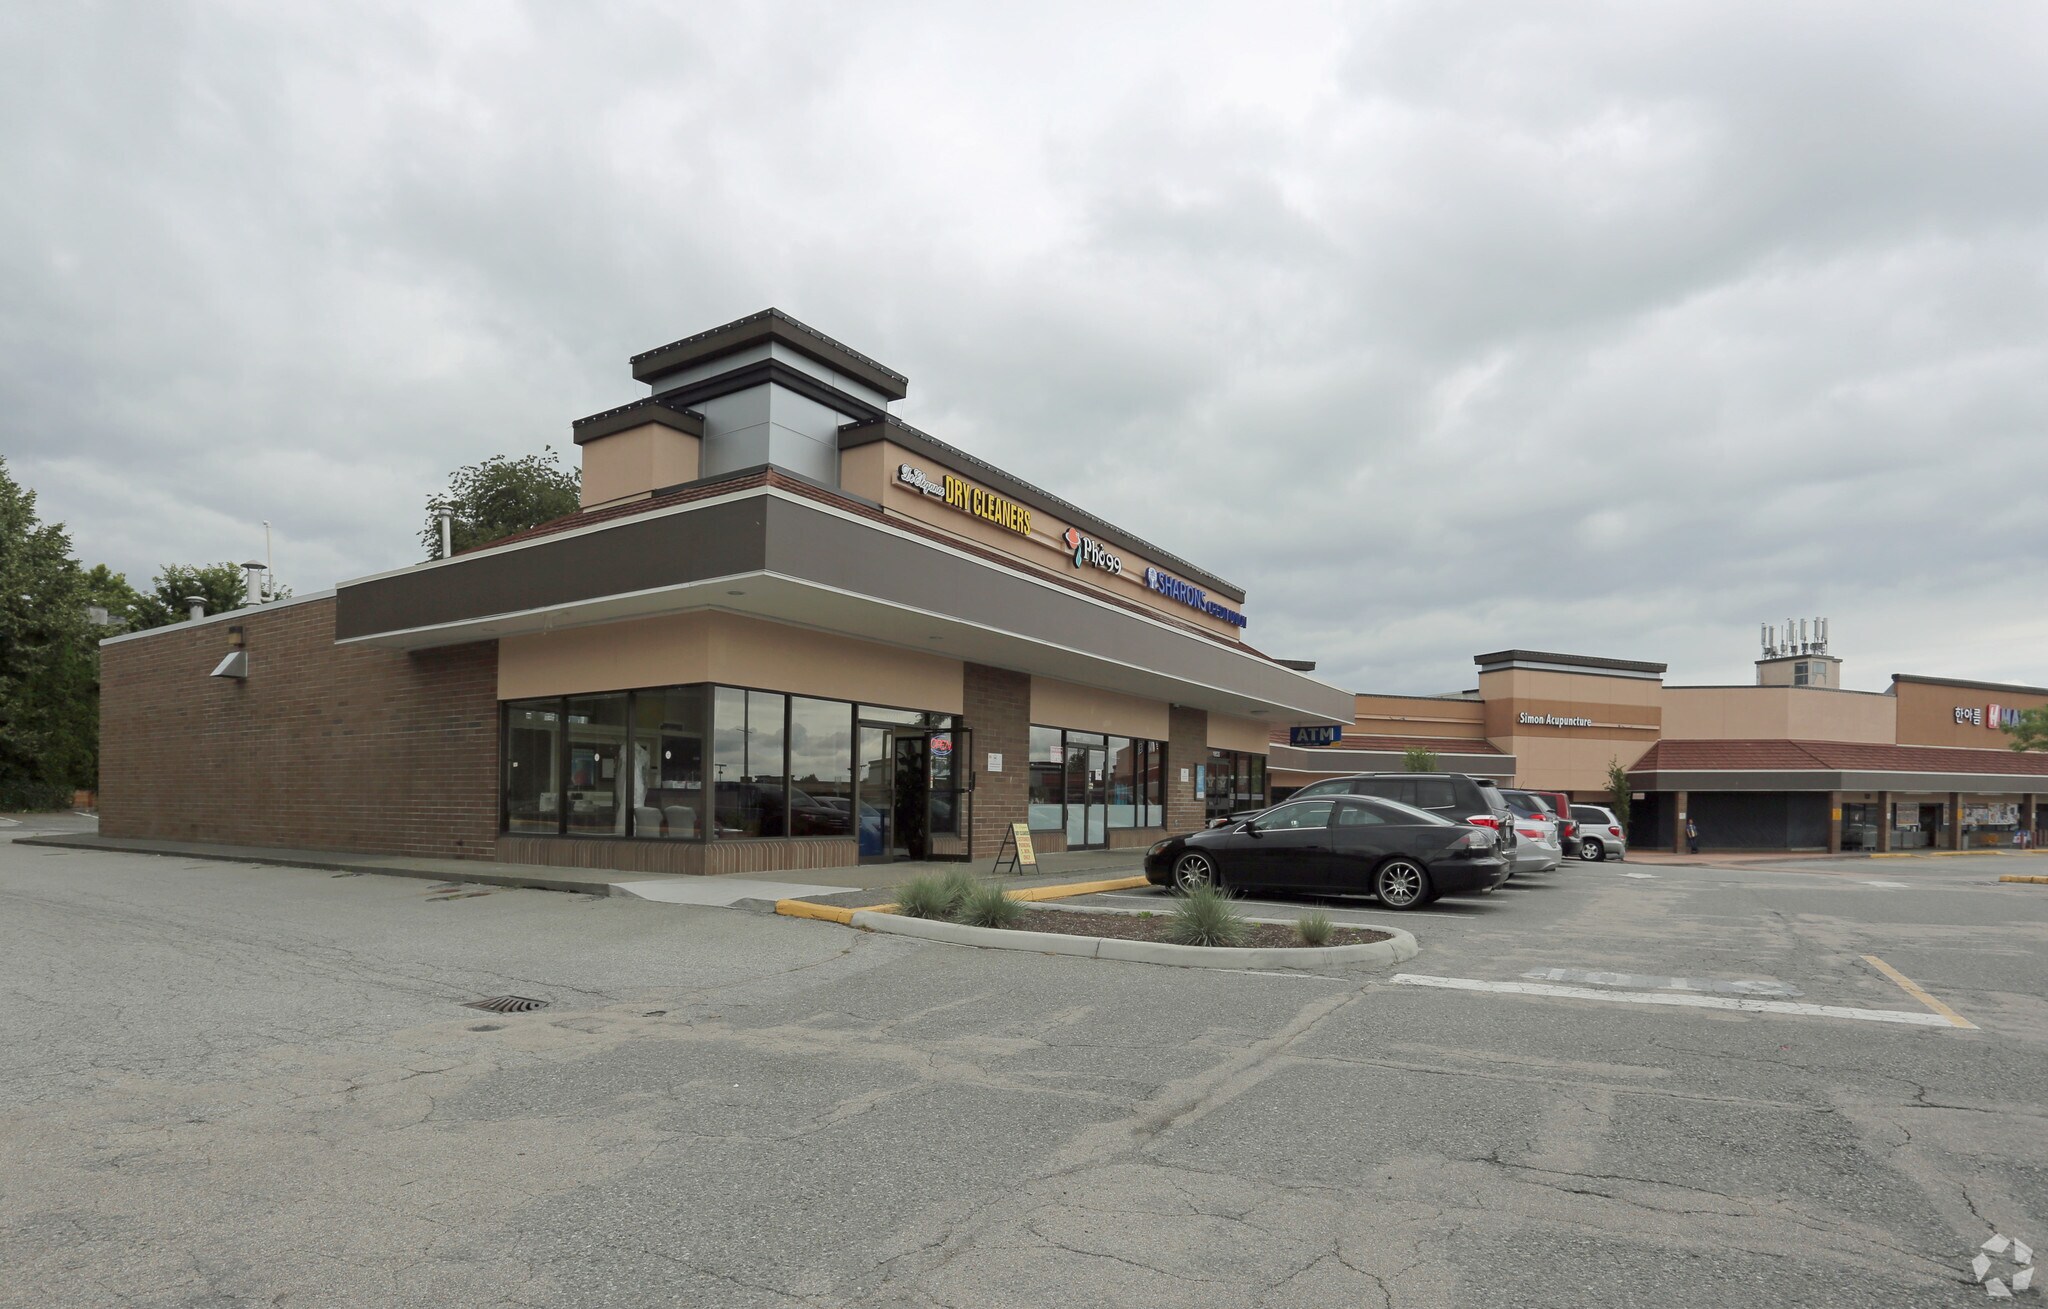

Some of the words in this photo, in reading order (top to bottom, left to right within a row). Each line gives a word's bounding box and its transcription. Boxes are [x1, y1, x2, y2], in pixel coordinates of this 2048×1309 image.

[944, 475, 971, 510] DRY
[972, 487, 1031, 536] CLEANERS
[1158, 571, 1207, 612] SHARONS
[1520, 712, 1544, 724] Simon
[1546, 714, 1592, 728] Acupuncture
[1955, 706, 1981, 725] 한아름
[1297, 727, 1334, 741] ATM
